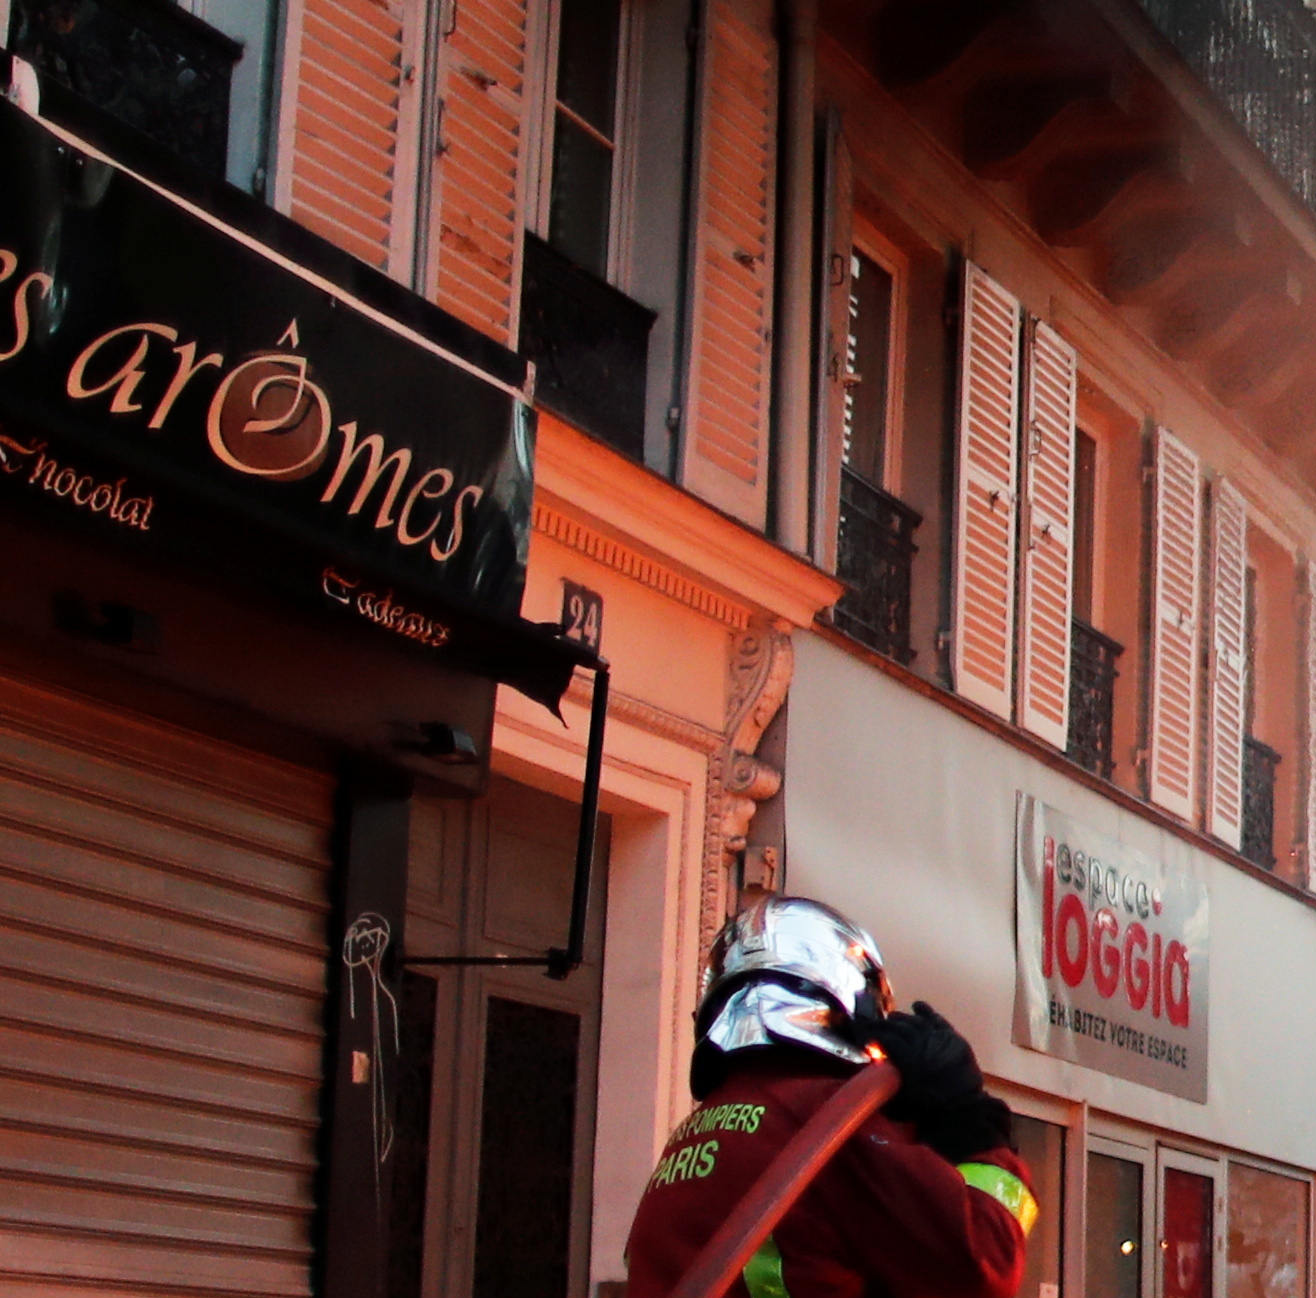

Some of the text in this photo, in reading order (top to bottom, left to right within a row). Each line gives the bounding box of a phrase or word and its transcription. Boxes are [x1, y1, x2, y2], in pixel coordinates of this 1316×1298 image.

[566, 594, 598, 648] 24
[1056, 843, 1150, 920] espace
[1110, 1022, 1145, 1055] VOTRE
[1147, 1036, 1187, 1069] ESPACE
[685, 1103, 766, 1138] POMPIERS
[652, 1139, 719, 1190] PARIS
